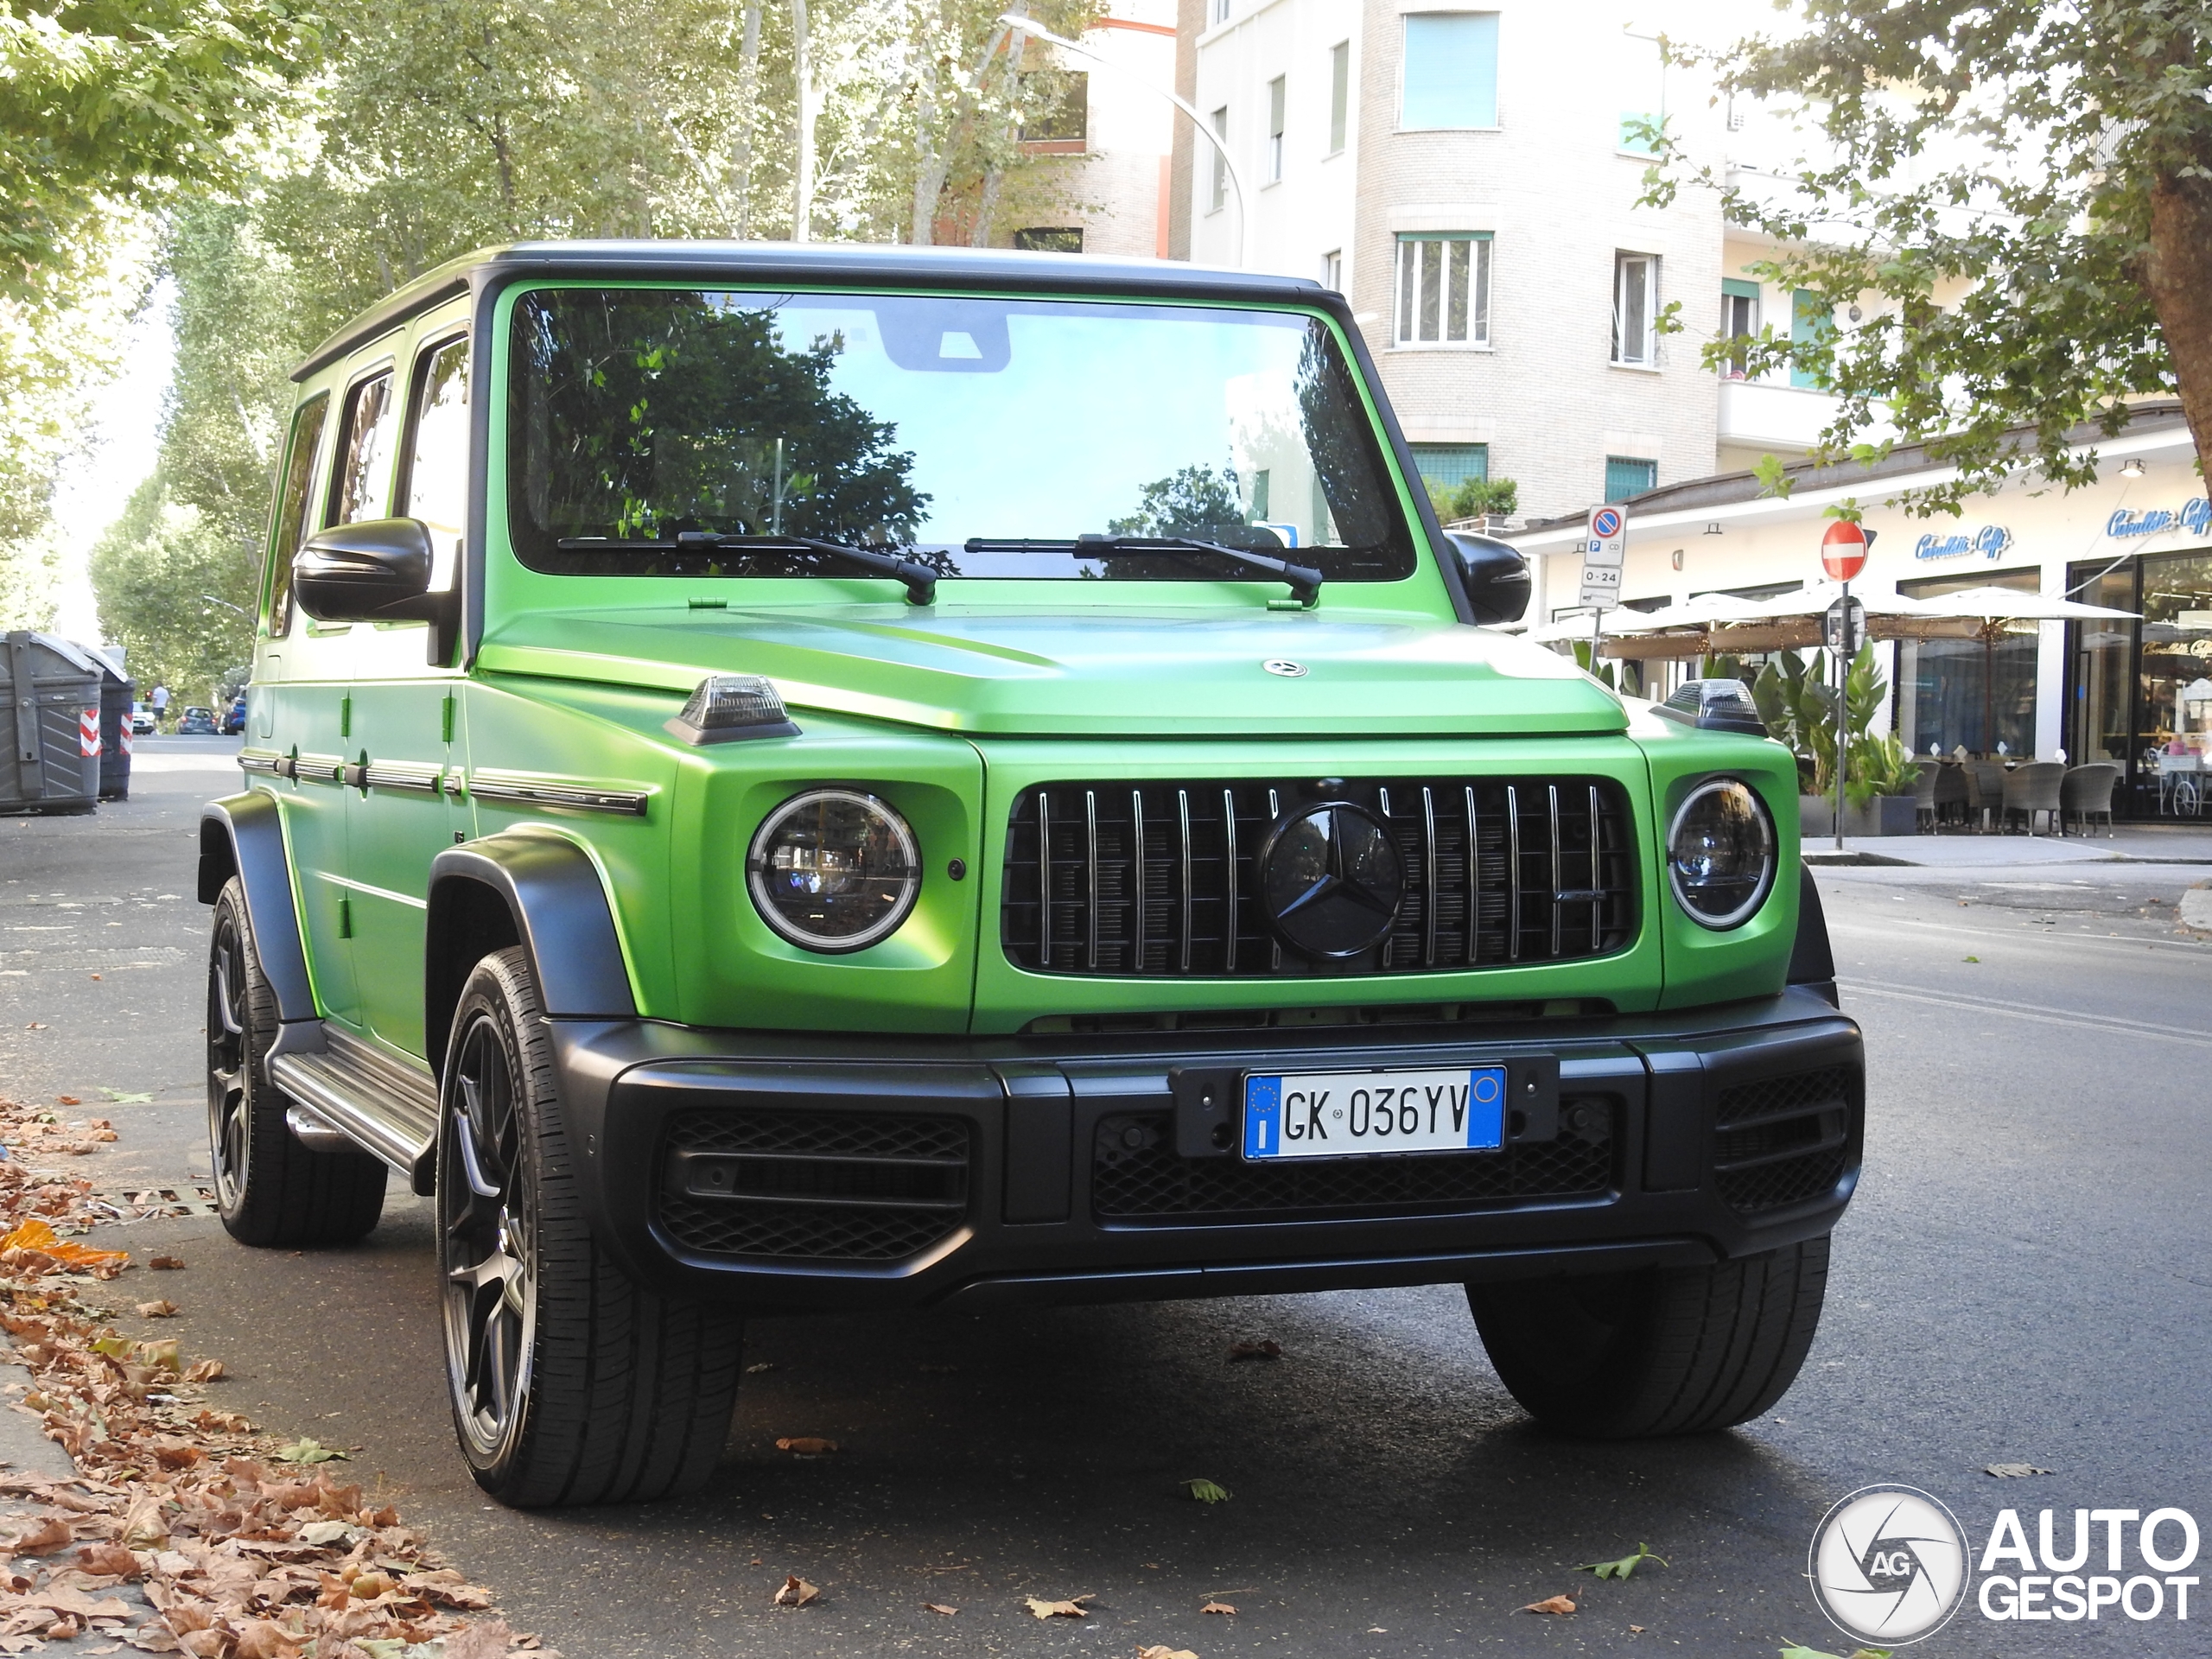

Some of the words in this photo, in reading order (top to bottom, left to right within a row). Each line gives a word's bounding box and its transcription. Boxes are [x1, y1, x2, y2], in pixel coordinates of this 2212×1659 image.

[499, 1007, 529, 1163] SCORPION
[1285, 1090, 1330, 1140] GK
[1349, 1084, 1469, 1136] 036YV
[1258, 1120, 1267, 1149] I
